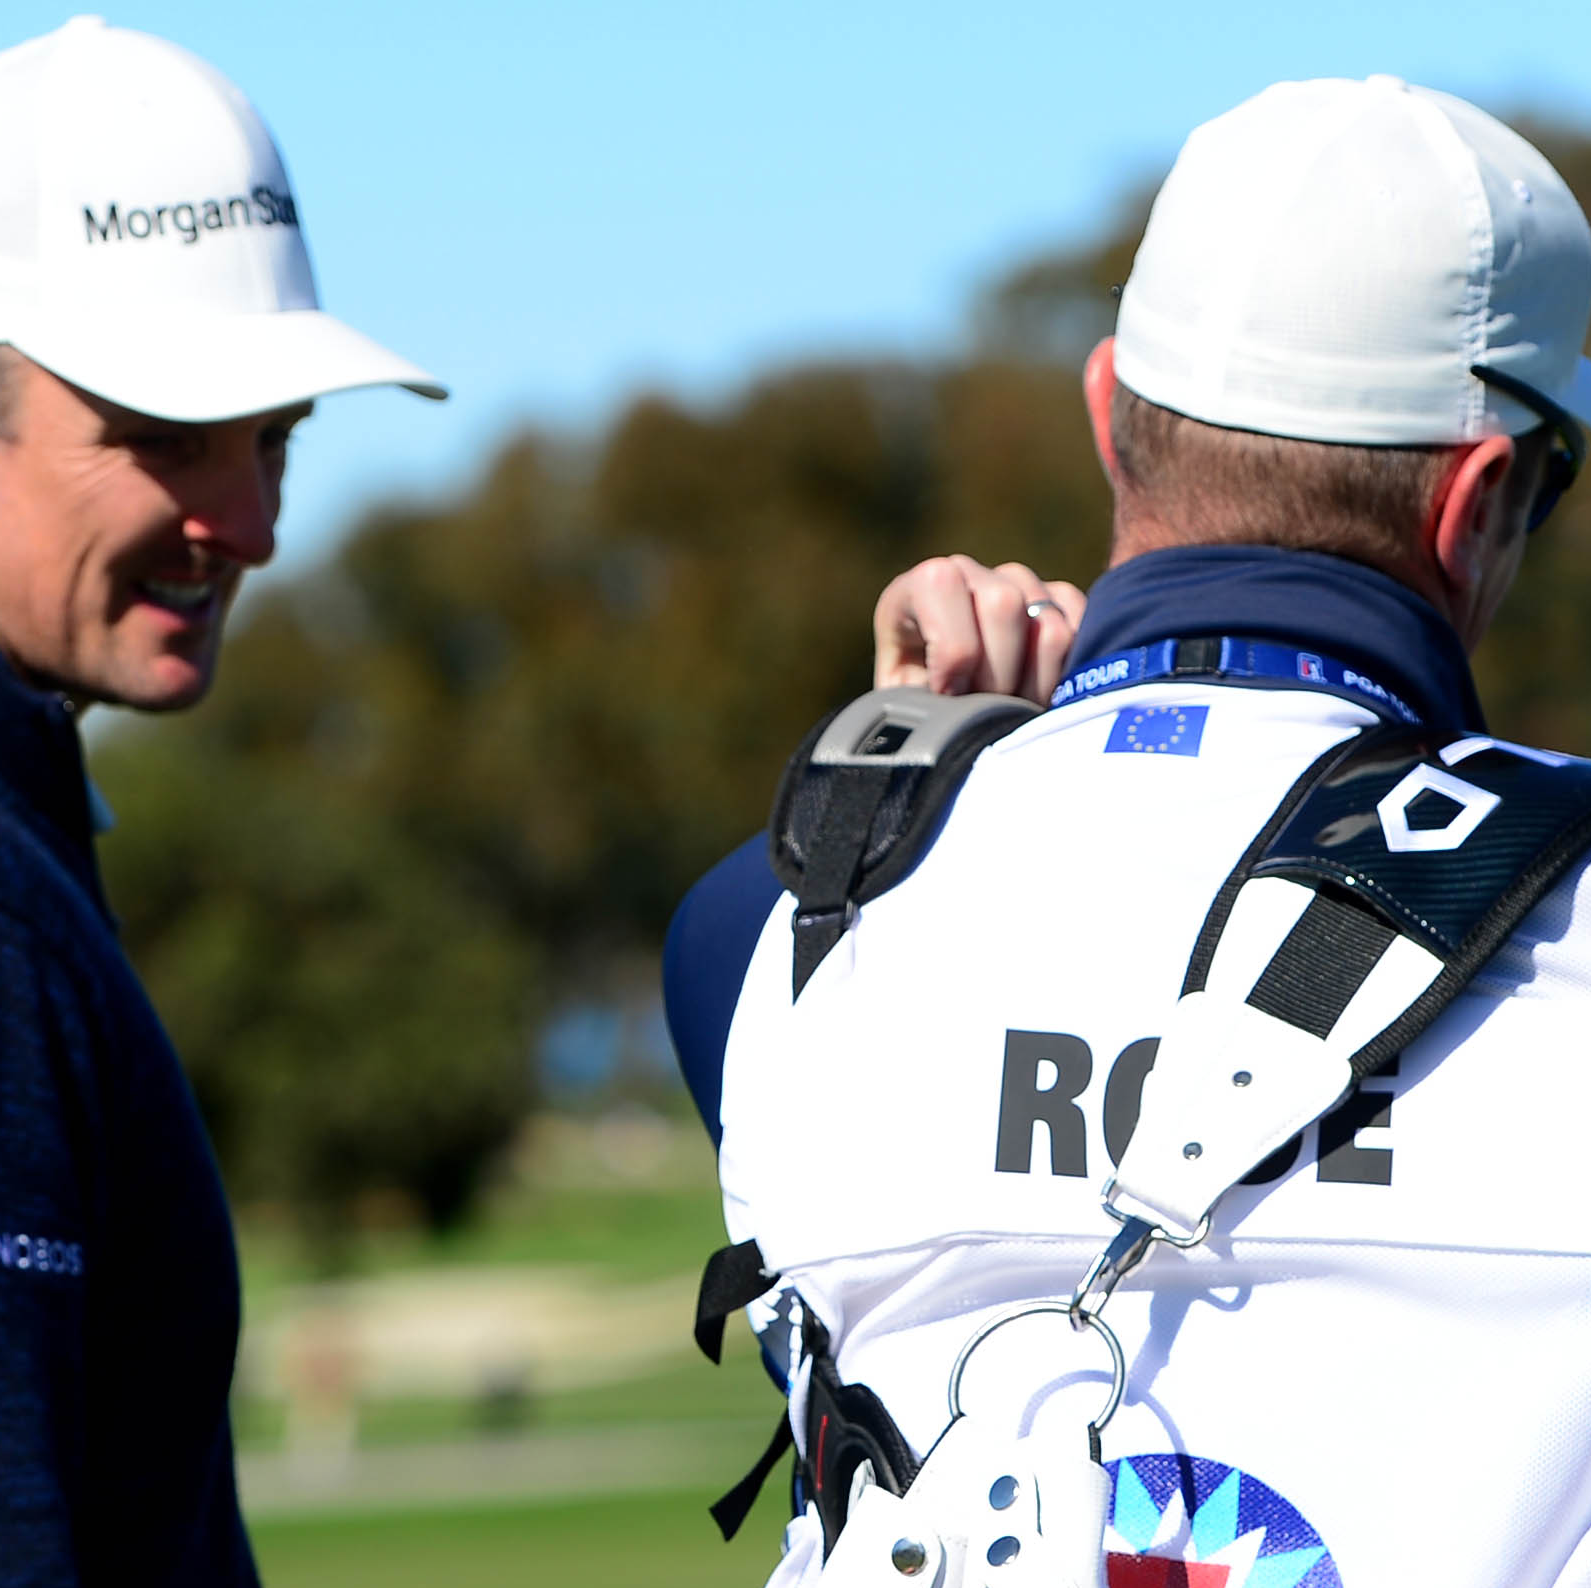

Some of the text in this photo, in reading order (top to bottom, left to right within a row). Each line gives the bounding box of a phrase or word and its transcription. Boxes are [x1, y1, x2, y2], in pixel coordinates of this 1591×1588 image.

[1074, 659, 1129, 694] TOUR
[1343, 669, 1389, 699] PGA
[994, 1028, 1400, 1186] RE
